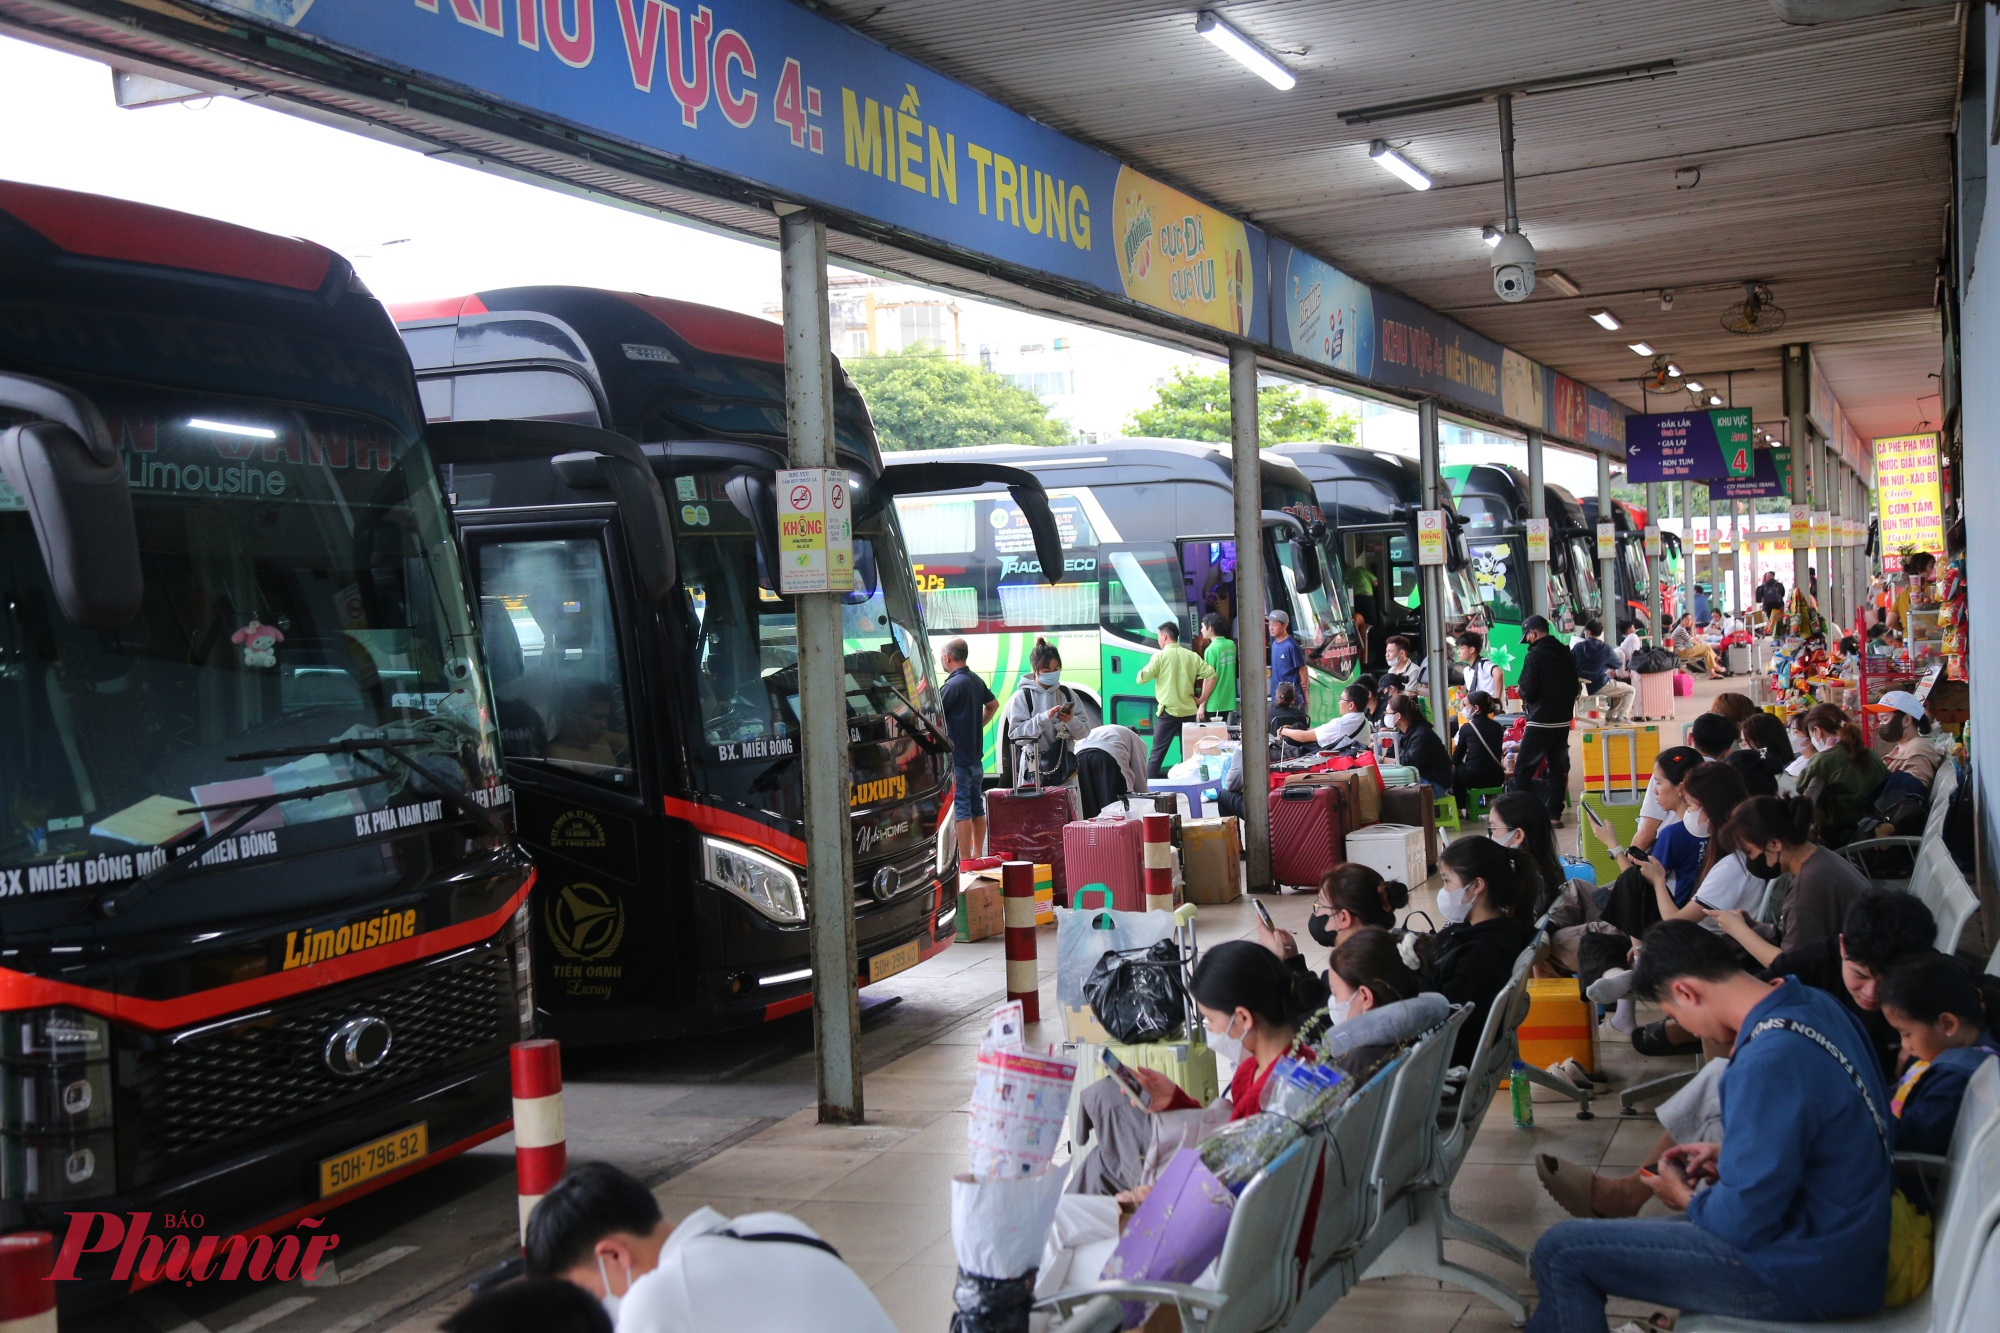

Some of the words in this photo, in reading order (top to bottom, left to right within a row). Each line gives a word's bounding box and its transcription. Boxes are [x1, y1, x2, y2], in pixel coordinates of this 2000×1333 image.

[617, 0, 757, 129] VỰC
[774, 57, 824, 155] 4:
[842, 83, 958, 205] MIỀN
[968, 142, 1092, 251] TRUNG
[1382, 318, 1408, 366] KHU
[1409, 326, 1432, 377] VỰC
[1445, 335, 1467, 385] MIỀN
[1468, 354, 1497, 397] TRUNG
[1717, 416, 1732, 427] KHU
[1733, 414, 1748, 428] VỰC
[1888, 439, 1902, 453] PHÊ
[1903, 440, 1917, 451] PHA
[125, 452, 287, 496] Limousine
[1732, 449, 1748, 473] 4
[1888, 502, 1910, 515] CƠM
[783, 515, 822, 537] KHÔNG
[1420, 531, 1441, 540] KHÔNG
[995, 555, 1097, 581] TRACECO
[718, 744, 740, 762] BX.
[769, 735, 793, 756] ĐÔNG
[850, 727, 861, 743] GA
[849, 774, 906, 807] Luxury
[355, 814, 372, 837] BX
[372, 804, 398, 833] PHÍA
[398, 803, 422, 828] NAM
[422, 799, 443, 823] BMT
[240, 830, 278, 859] ĐÔNG
[84, 853, 133, 885] ĐÔNG
[283, 908, 416, 971] Limousine
[553, 962, 582, 978] TIẾN
[586, 965, 622, 978] OANH
[1790, 1020, 1855, 1076] FASHION
[329, 1131, 419, 1187] 50H-796.92
